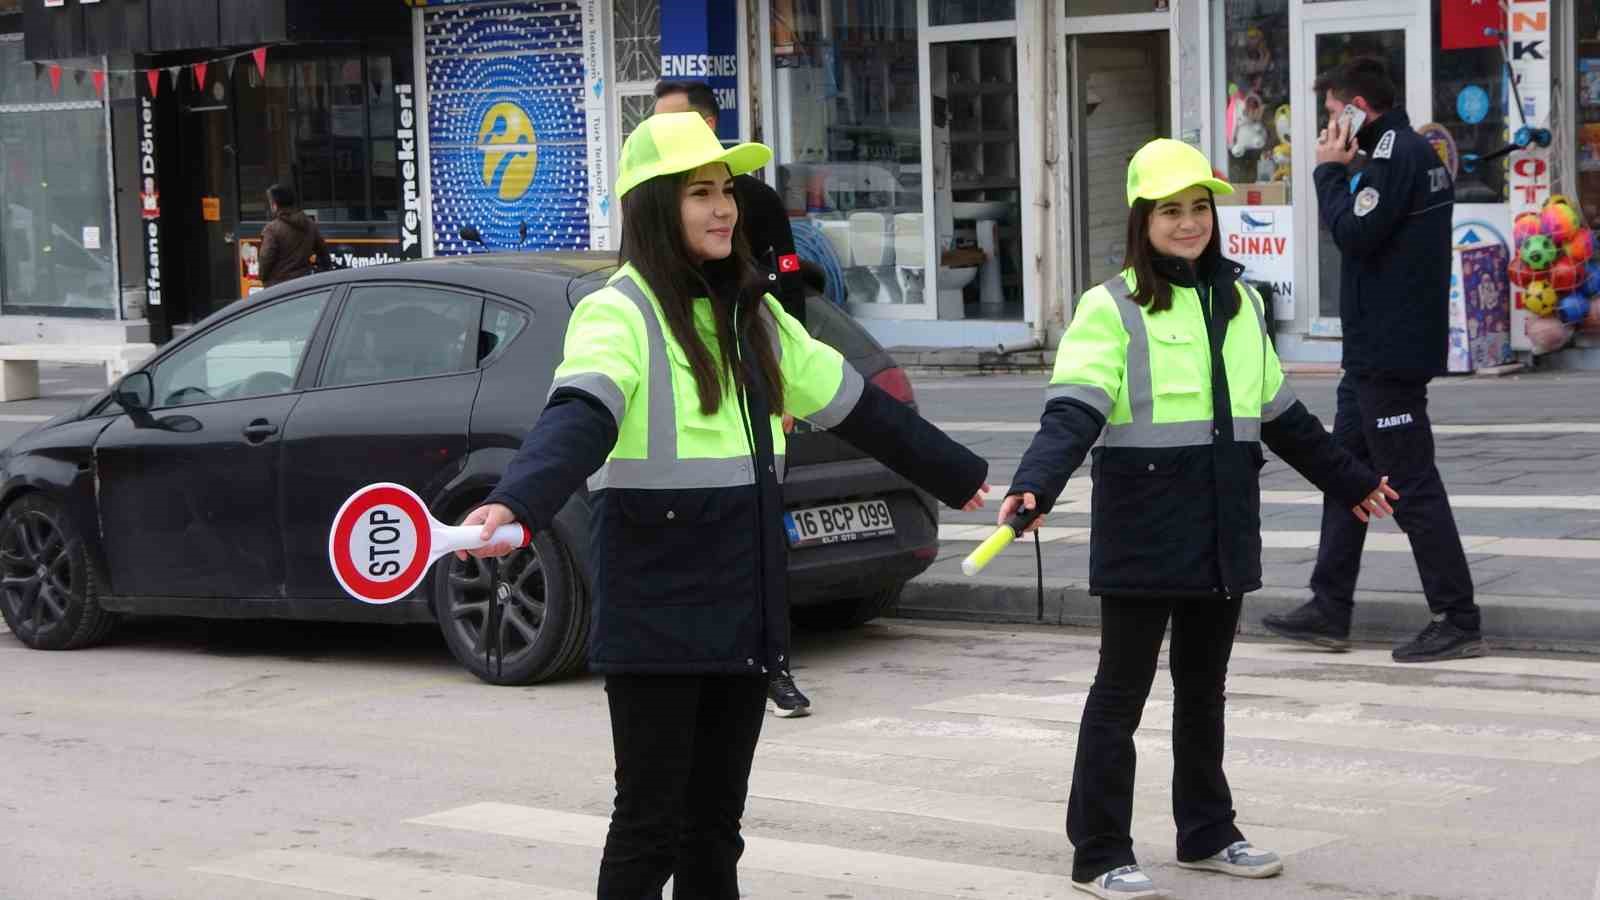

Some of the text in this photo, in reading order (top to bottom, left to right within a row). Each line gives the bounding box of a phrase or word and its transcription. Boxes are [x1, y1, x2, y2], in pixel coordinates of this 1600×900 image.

[661, 54, 707, 77] ENES
[706, 55, 737, 77] ENES
[141, 96, 155, 175] Döner
[395, 84, 418, 252] Yemekleri
[1228, 234, 1287, 255] SINAV
[147, 221, 161, 305] Efsane
[1376, 412, 1413, 428] ZABITA
[795, 502, 890, 536] 16 BCP 099
[368, 509, 401, 577] STOP
